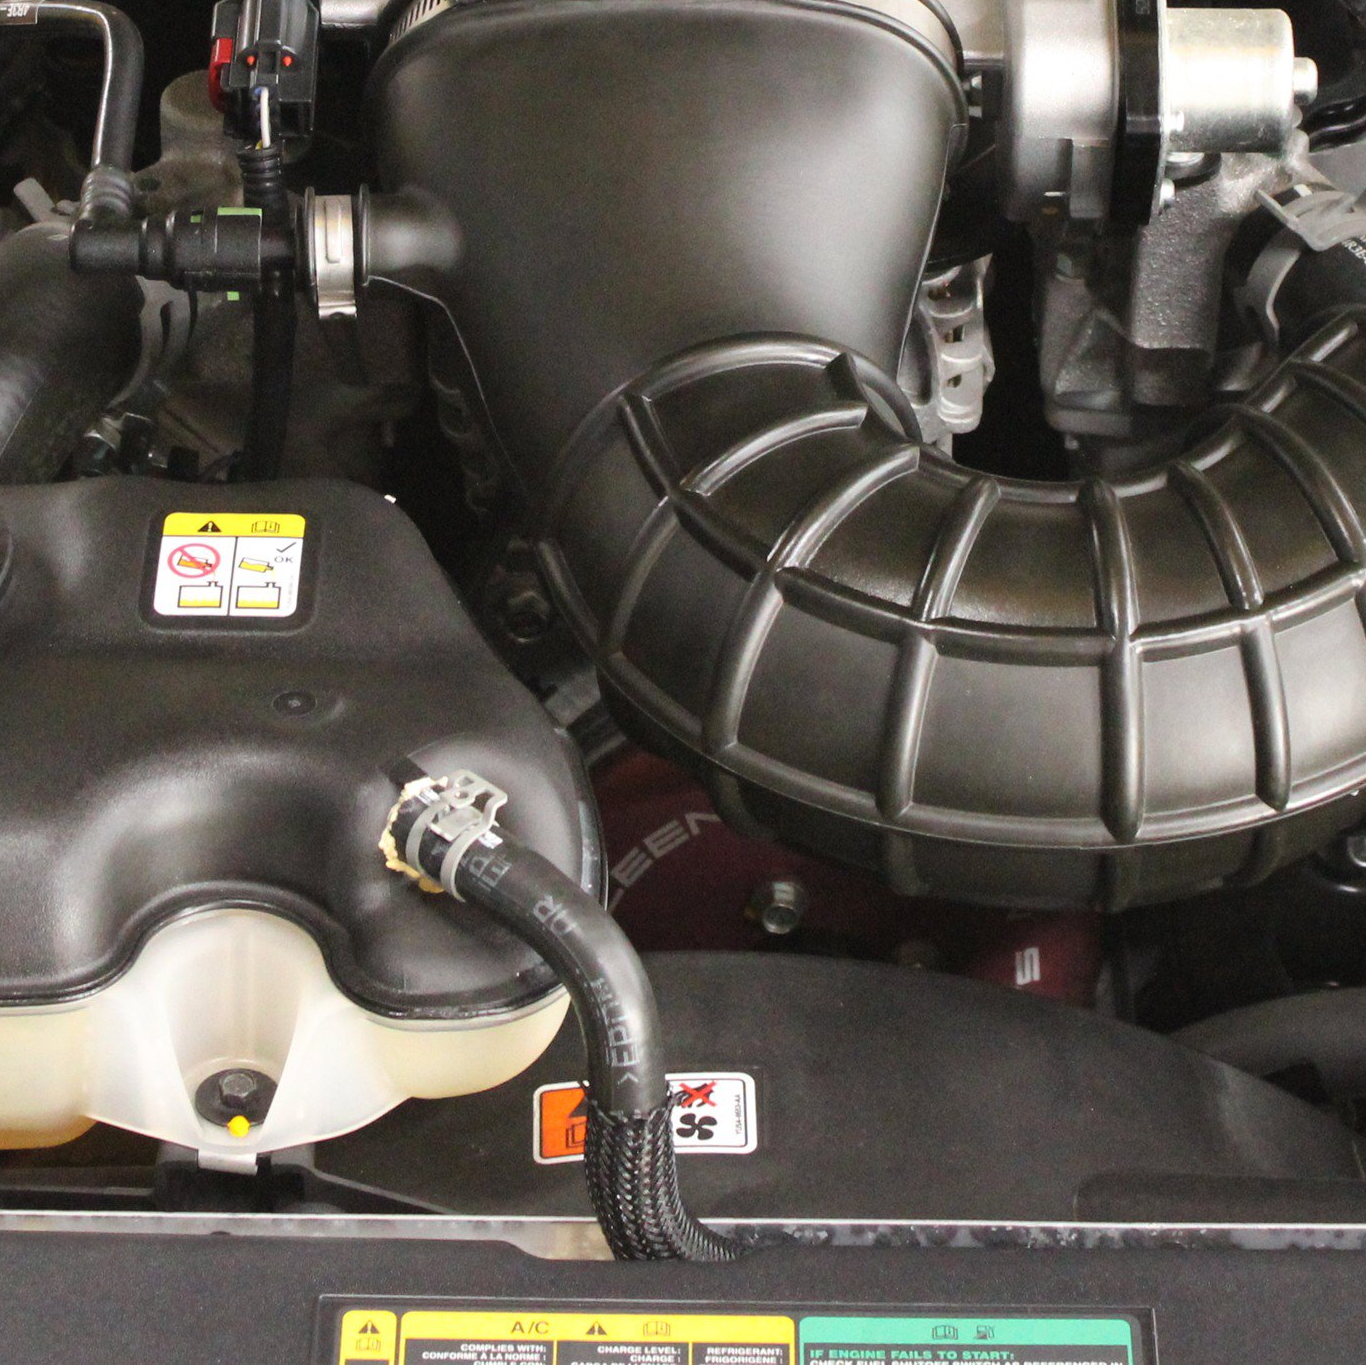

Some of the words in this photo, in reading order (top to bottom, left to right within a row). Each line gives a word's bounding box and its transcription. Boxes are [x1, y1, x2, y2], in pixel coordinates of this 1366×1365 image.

[274, 555, 294, 564] OK
[511, 1320, 550, 1335] A/C
[460, 1343, 515, 1352] COMPLIES
[597, 1345, 643, 1354] CHARGE
[422, 1351, 478, 1360] CONFORME
[490, 1352, 503, 1360] LA
[629, 1354, 675, 1363] CHARGE
[809, 1349, 824, 1359] IF
[828, 1349, 886, 1360] ENGINE
[890, 1350, 933, 1360] FAILS
[937, 1350, 958, 1360] TO
[962, 1350, 1015, 1361] START:
